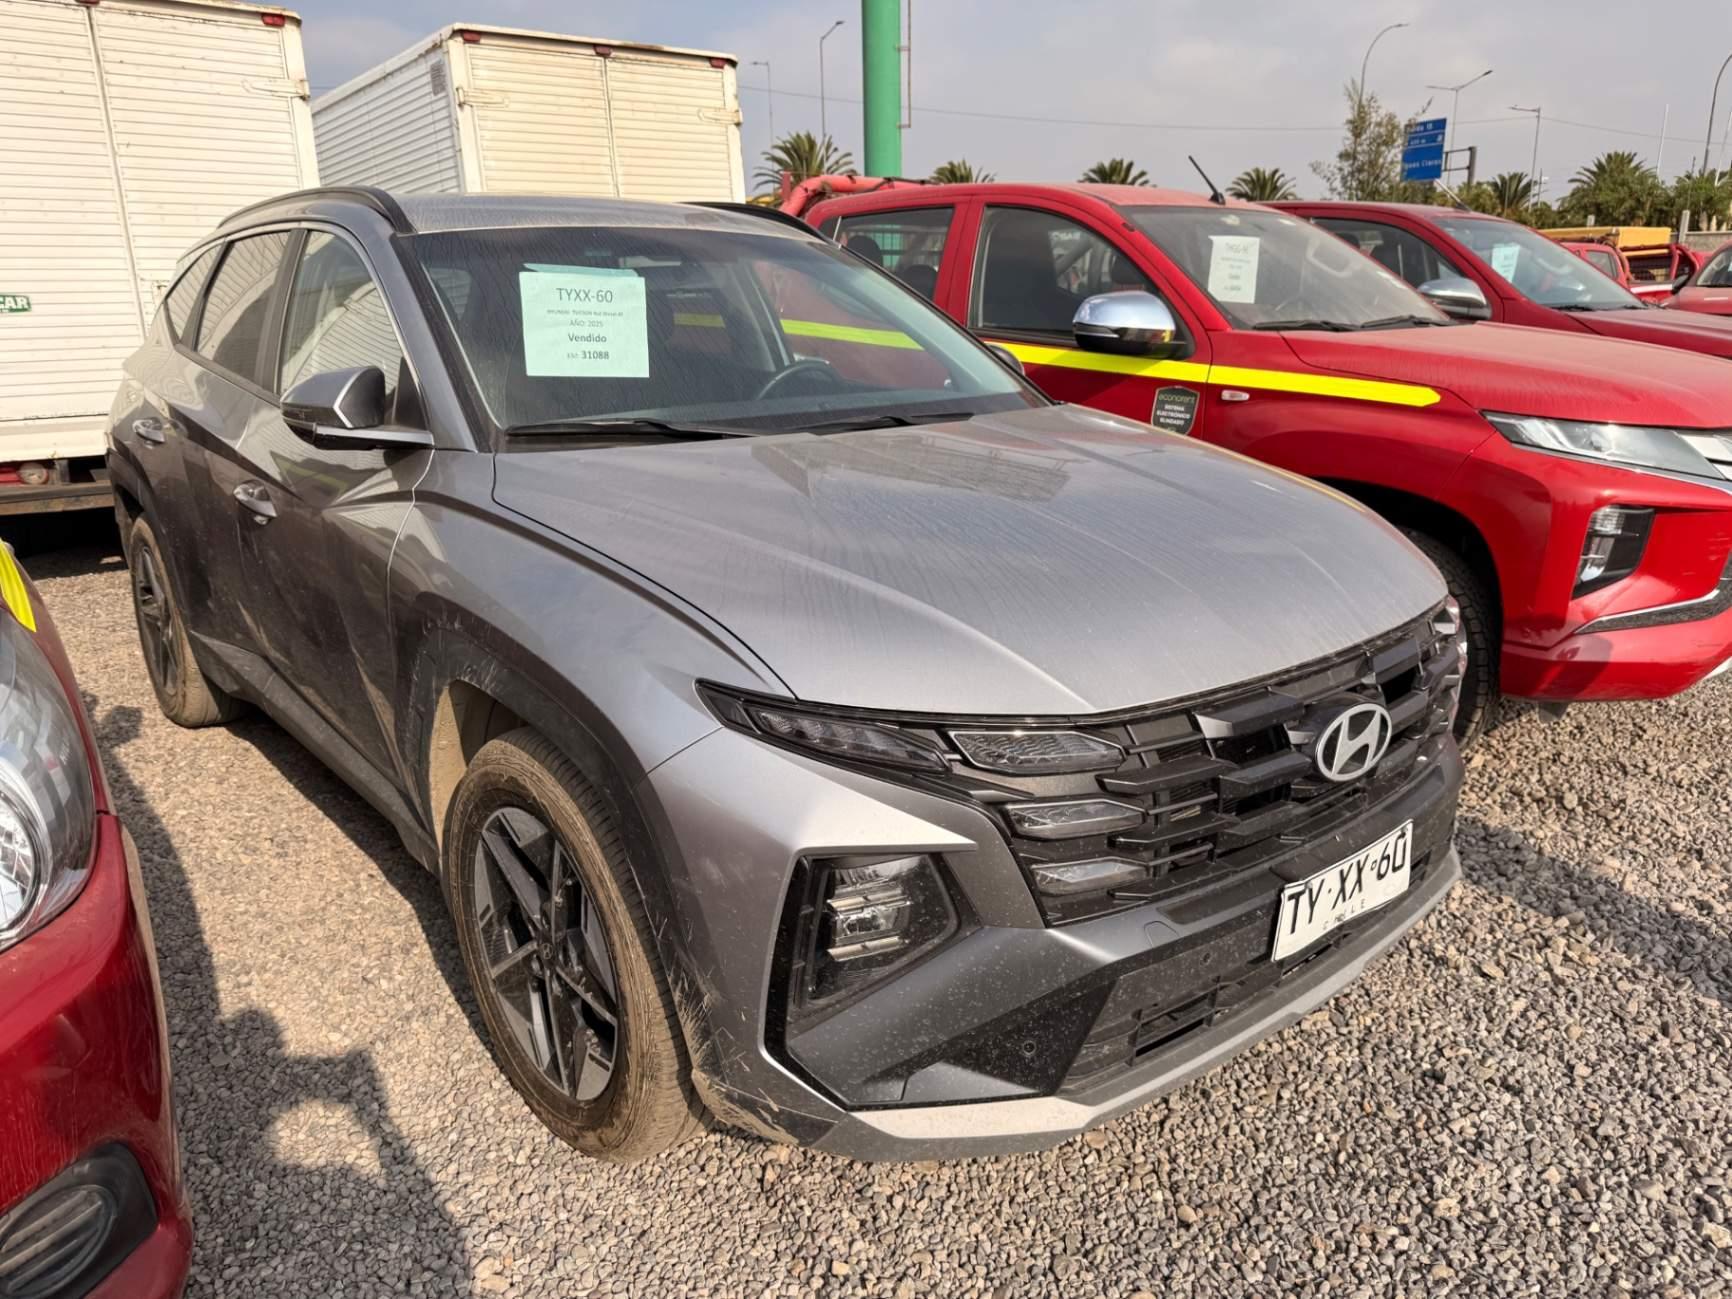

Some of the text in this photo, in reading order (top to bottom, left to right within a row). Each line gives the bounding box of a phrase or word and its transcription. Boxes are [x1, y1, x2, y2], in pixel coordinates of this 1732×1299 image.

[556, 287, 613, 304] TYXX-60
[588, 319, 604, 328] 2025
[568, 333, 607, 343] Vendido
[581, 350, 610, 360] 31088
